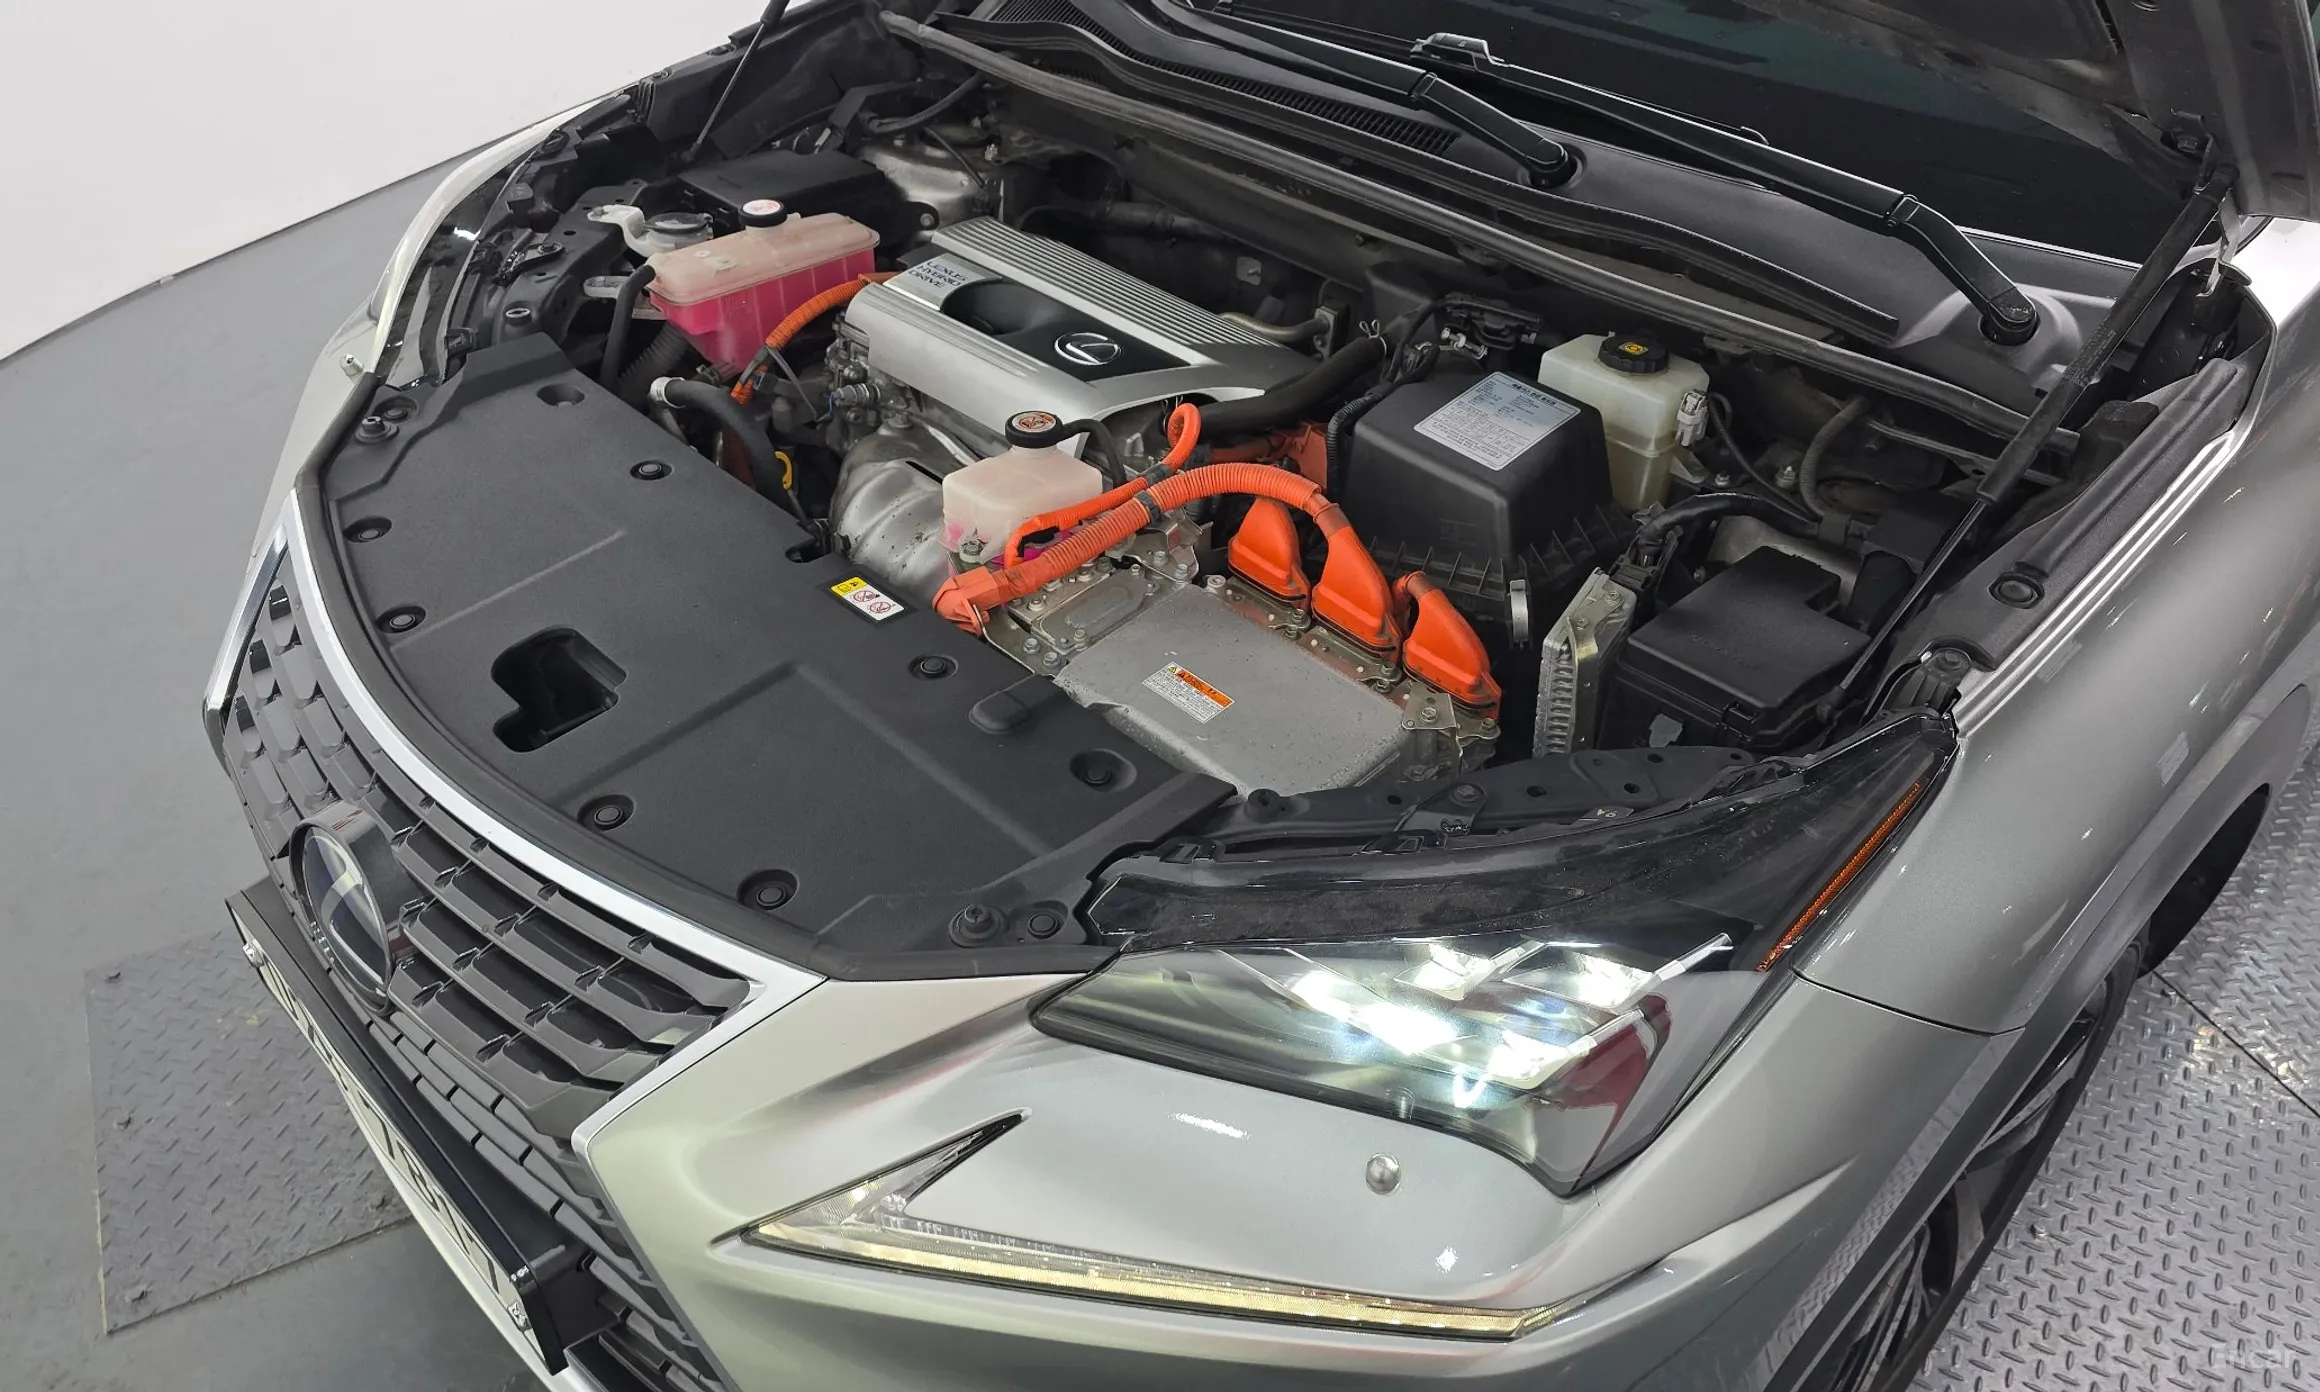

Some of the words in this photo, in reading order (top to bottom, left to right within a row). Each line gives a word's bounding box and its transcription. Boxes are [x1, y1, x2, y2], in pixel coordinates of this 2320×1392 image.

[908, 269, 946, 288] DRIVE
[916, 265, 961, 287] HYBRID
[927, 260, 968, 281] LEXUS
